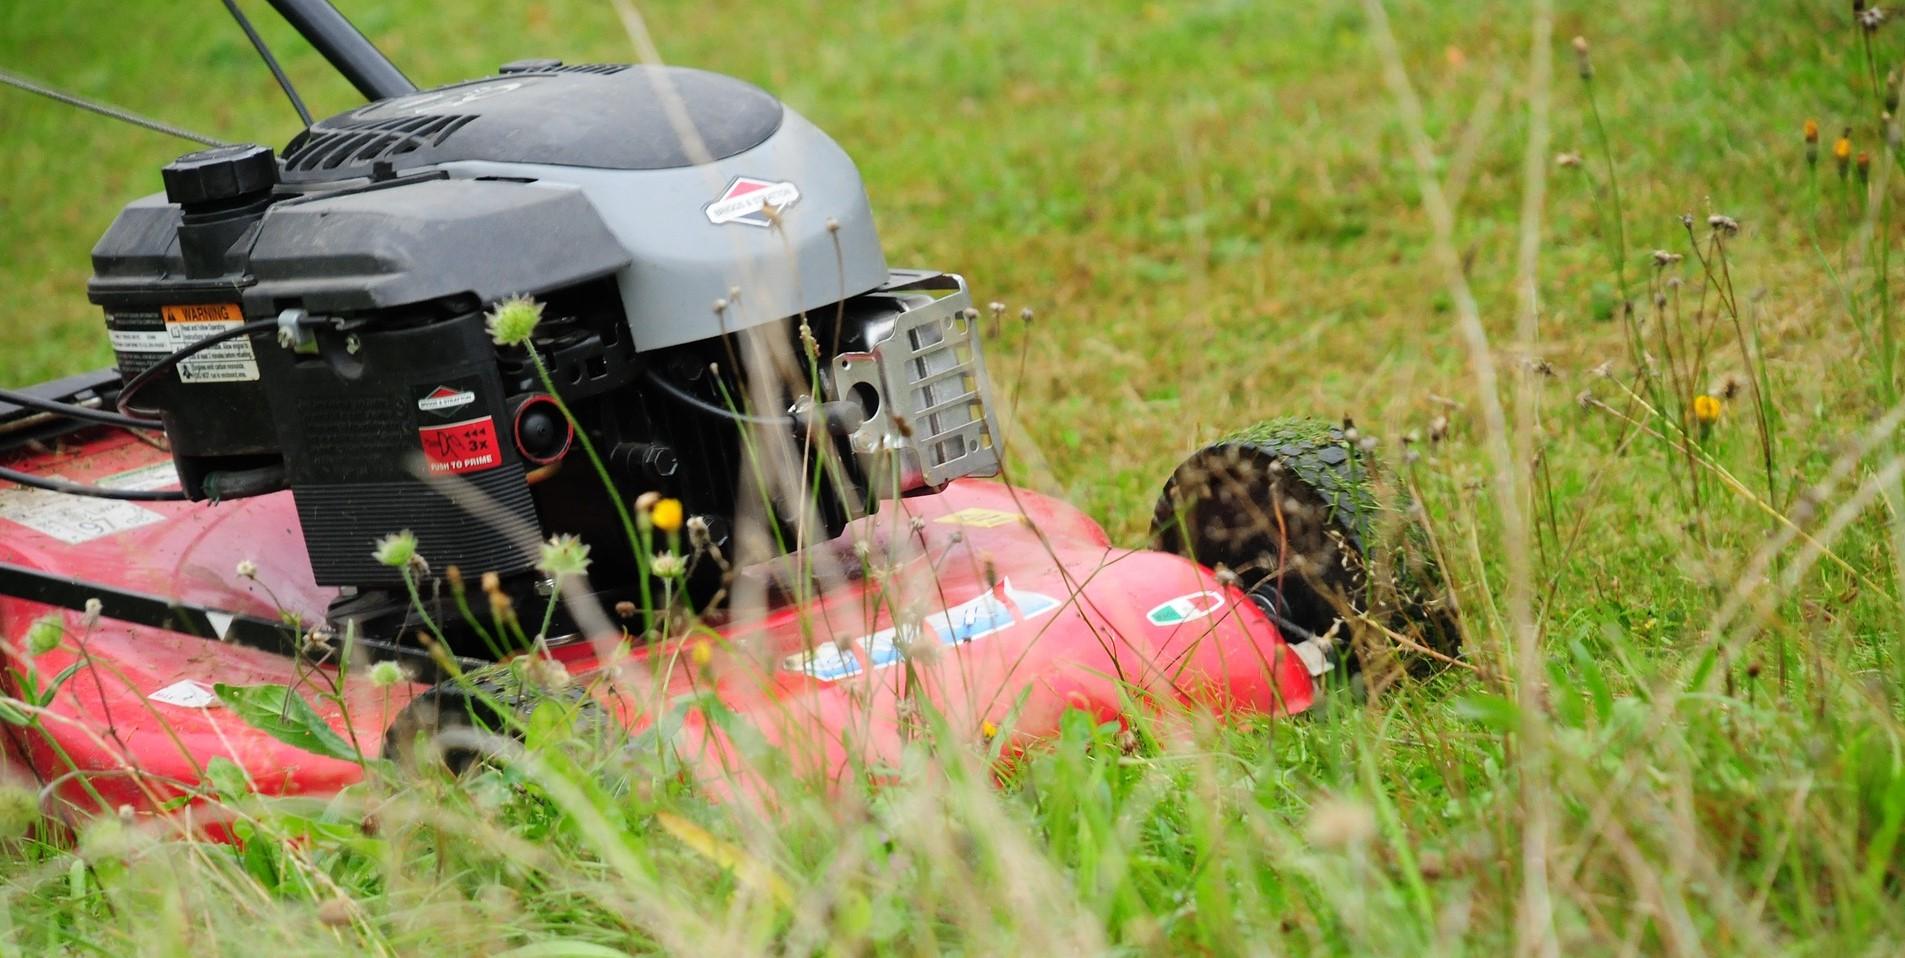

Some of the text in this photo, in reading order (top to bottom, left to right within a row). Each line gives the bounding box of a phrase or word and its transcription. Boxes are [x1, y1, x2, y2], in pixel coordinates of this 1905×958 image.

[183, 306, 230, 321] WARNING
[431, 454, 493, 471] PUSH TO PRIME
